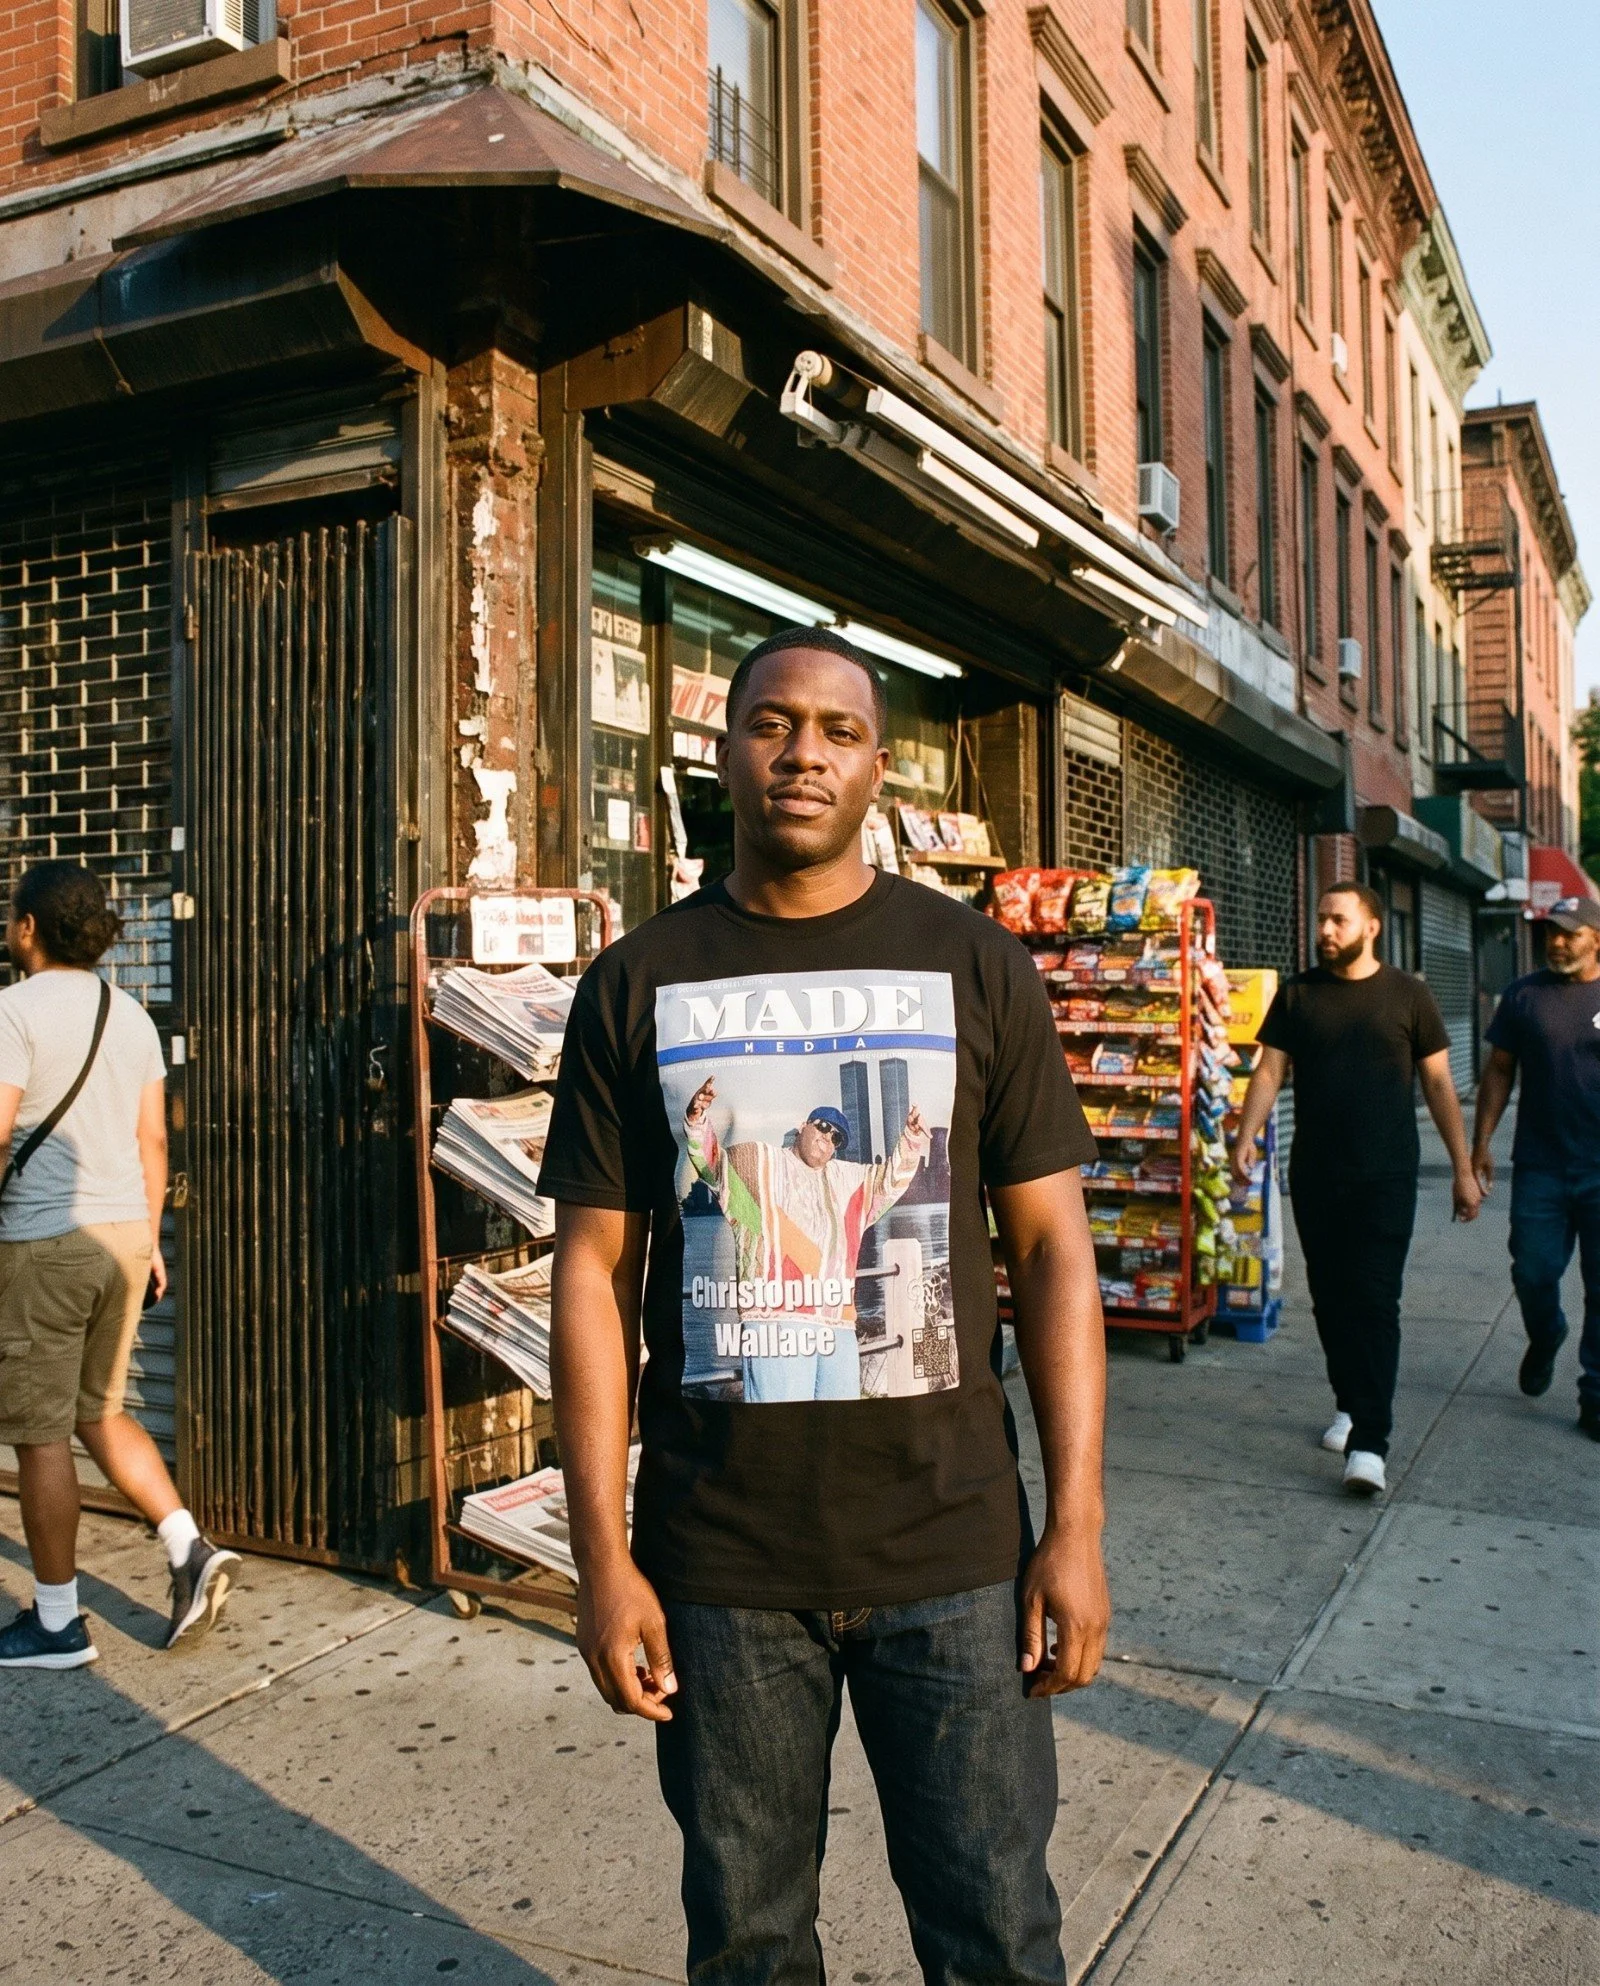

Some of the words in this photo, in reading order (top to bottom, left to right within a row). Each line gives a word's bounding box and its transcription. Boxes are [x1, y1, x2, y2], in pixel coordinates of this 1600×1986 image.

[680, 985, 924, 1043] MADE
[692, 1275, 855, 1312] Christopher
[715, 1322, 835, 1357] Wallace
